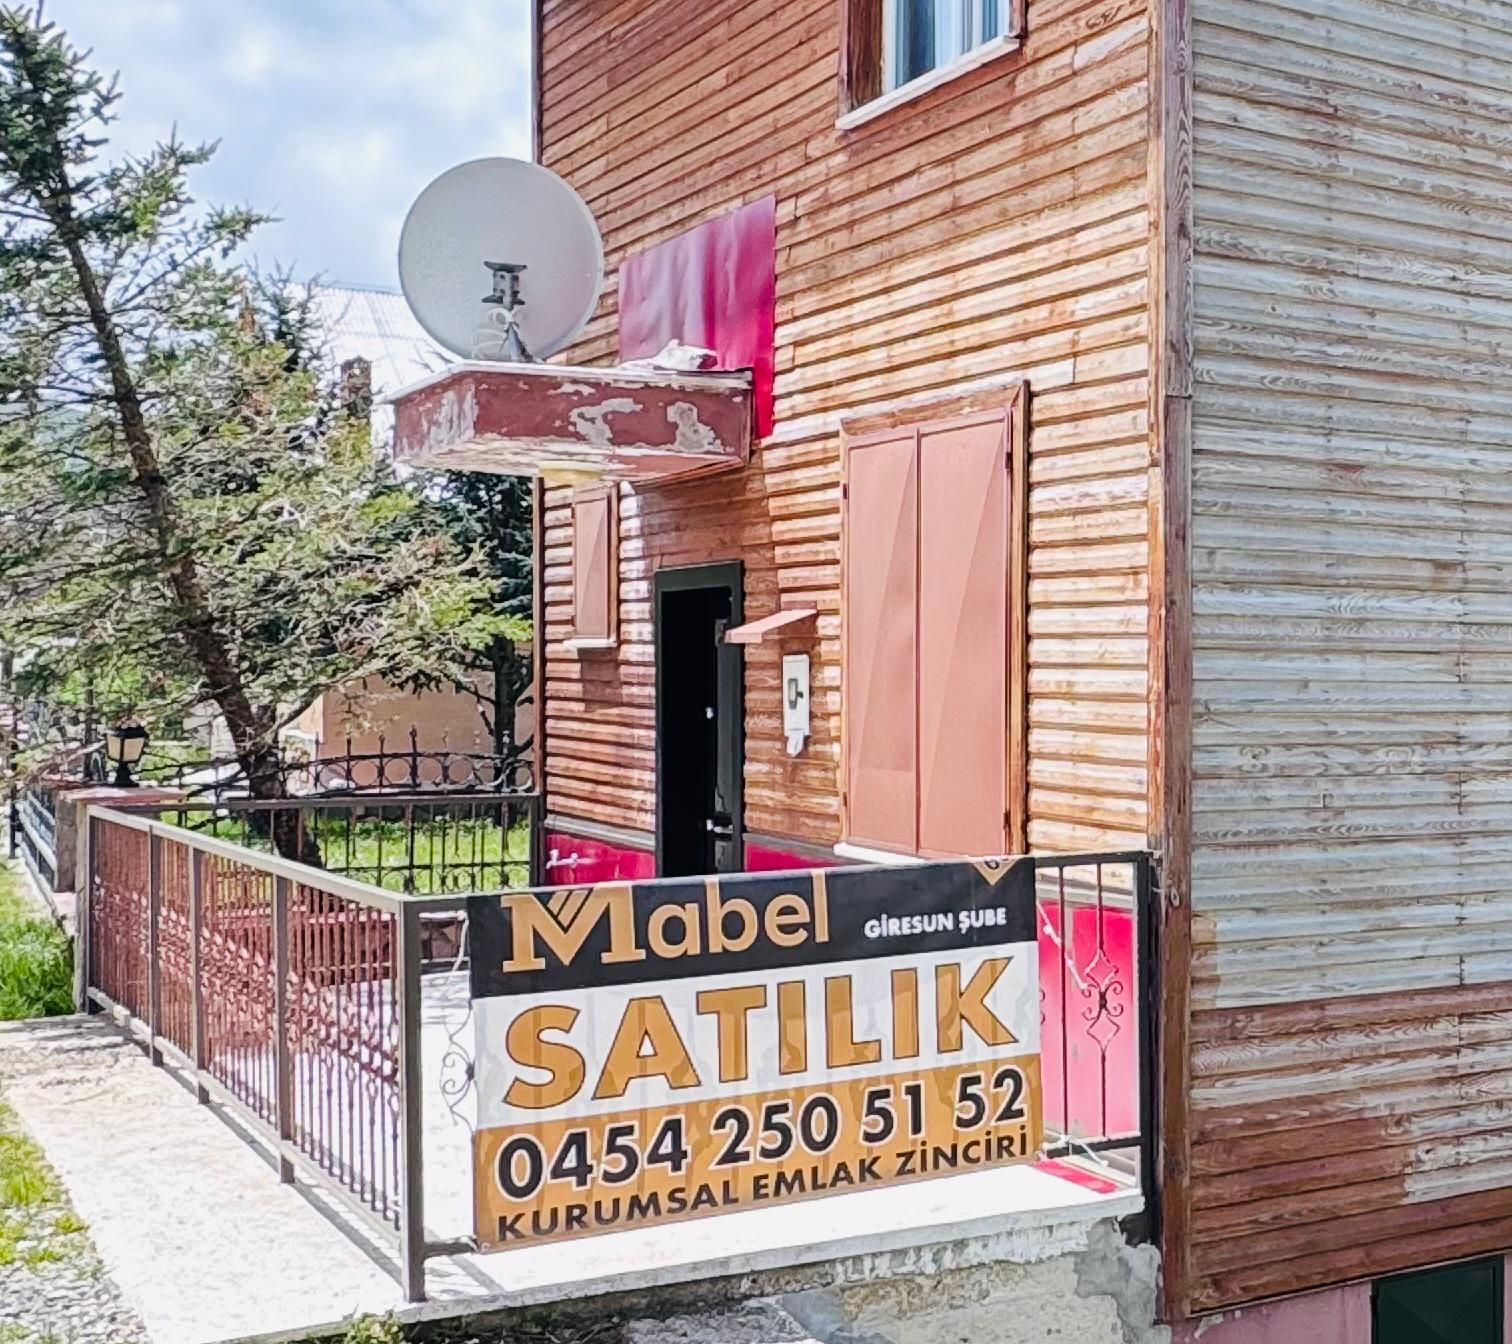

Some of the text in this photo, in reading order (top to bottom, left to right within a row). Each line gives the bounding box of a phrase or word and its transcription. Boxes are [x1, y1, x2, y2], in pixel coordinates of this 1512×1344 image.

[502, 869, 829, 972] Mabel
[863, 906, 1007, 940] GİRESUN ŞUBE
[502, 956, 1019, 1110] SATILIK
[497, 1067, 1025, 1202] 0454 250 51 52
[498, 1124, 1029, 1242] KURUMSAL EMLAK ZİNCİRİ
